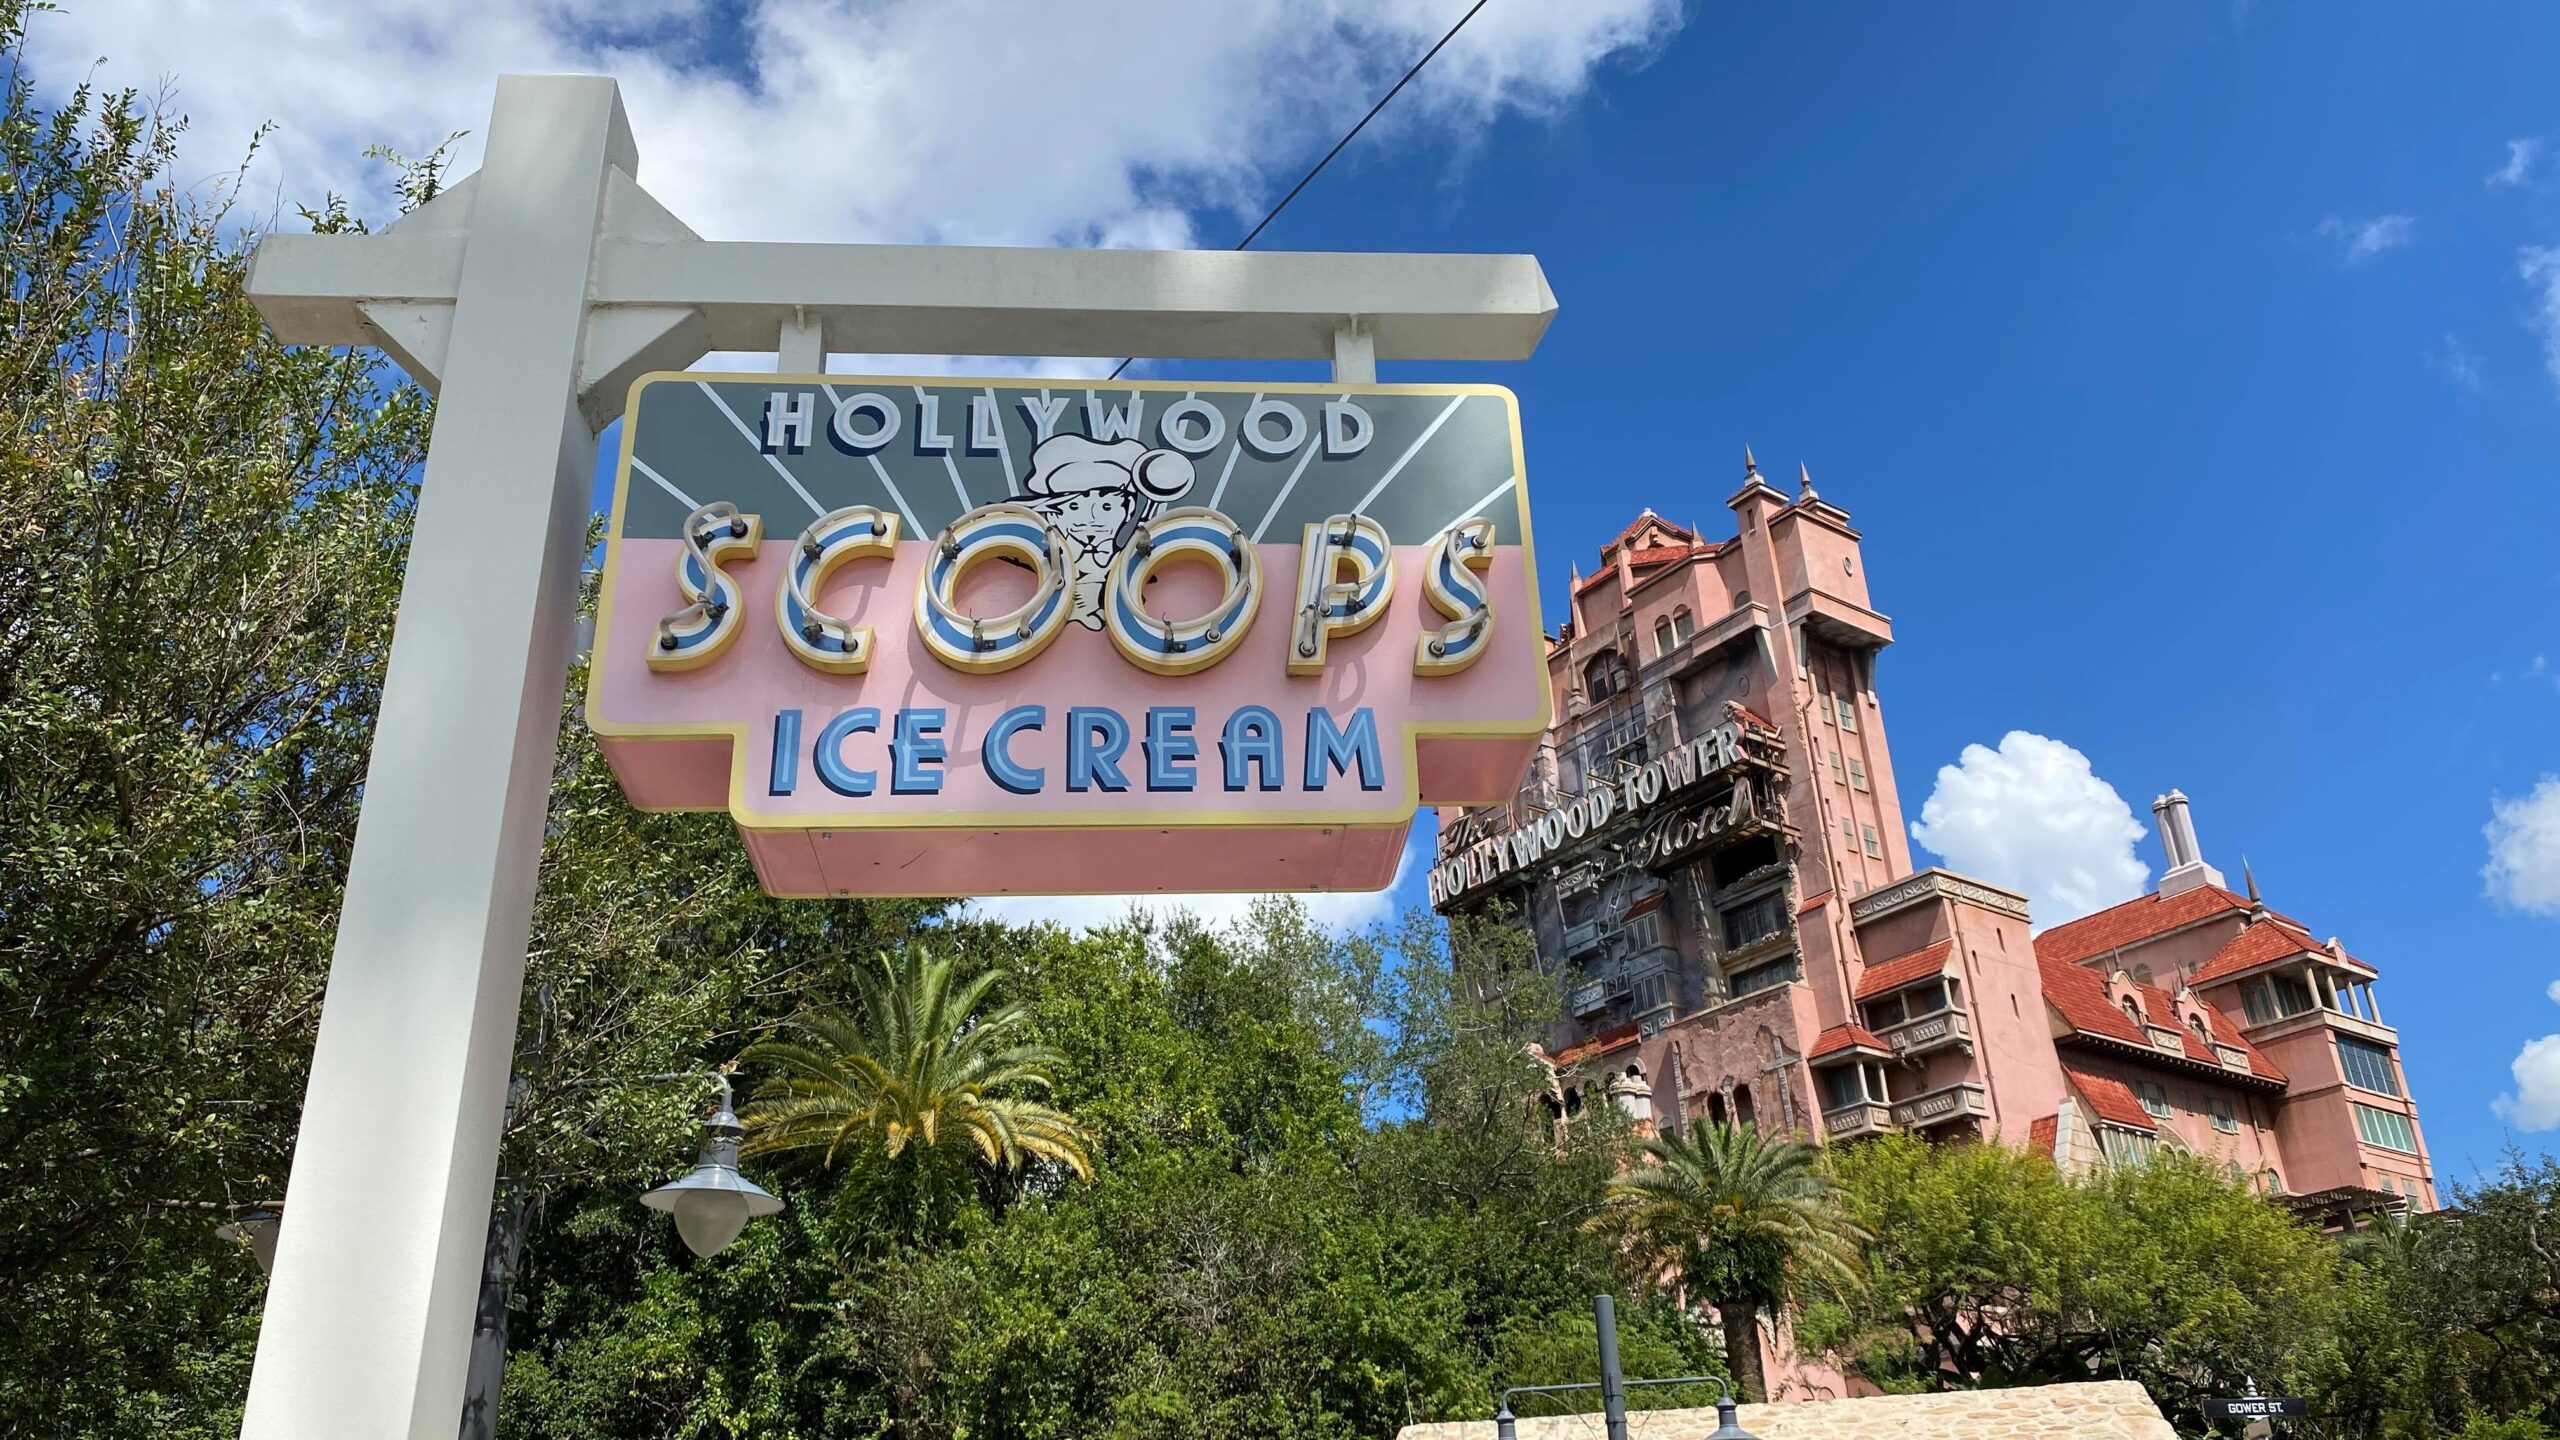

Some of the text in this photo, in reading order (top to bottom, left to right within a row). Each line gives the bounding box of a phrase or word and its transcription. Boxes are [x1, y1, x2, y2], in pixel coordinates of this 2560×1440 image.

[760, 390, 1375, 460] HOLLYWOOD
[645, 501, 1496, 676] SCOOPS
[768, 704, 1386, 797] ICE CREAM
[1427, 720, 1748, 908] HOLLYWOOD TOWER
[1440, 812, 1495, 858] The
[1633, 775, 1752, 869] Hotel
[2227, 1402, 2284, 1414] GOWER ST.
